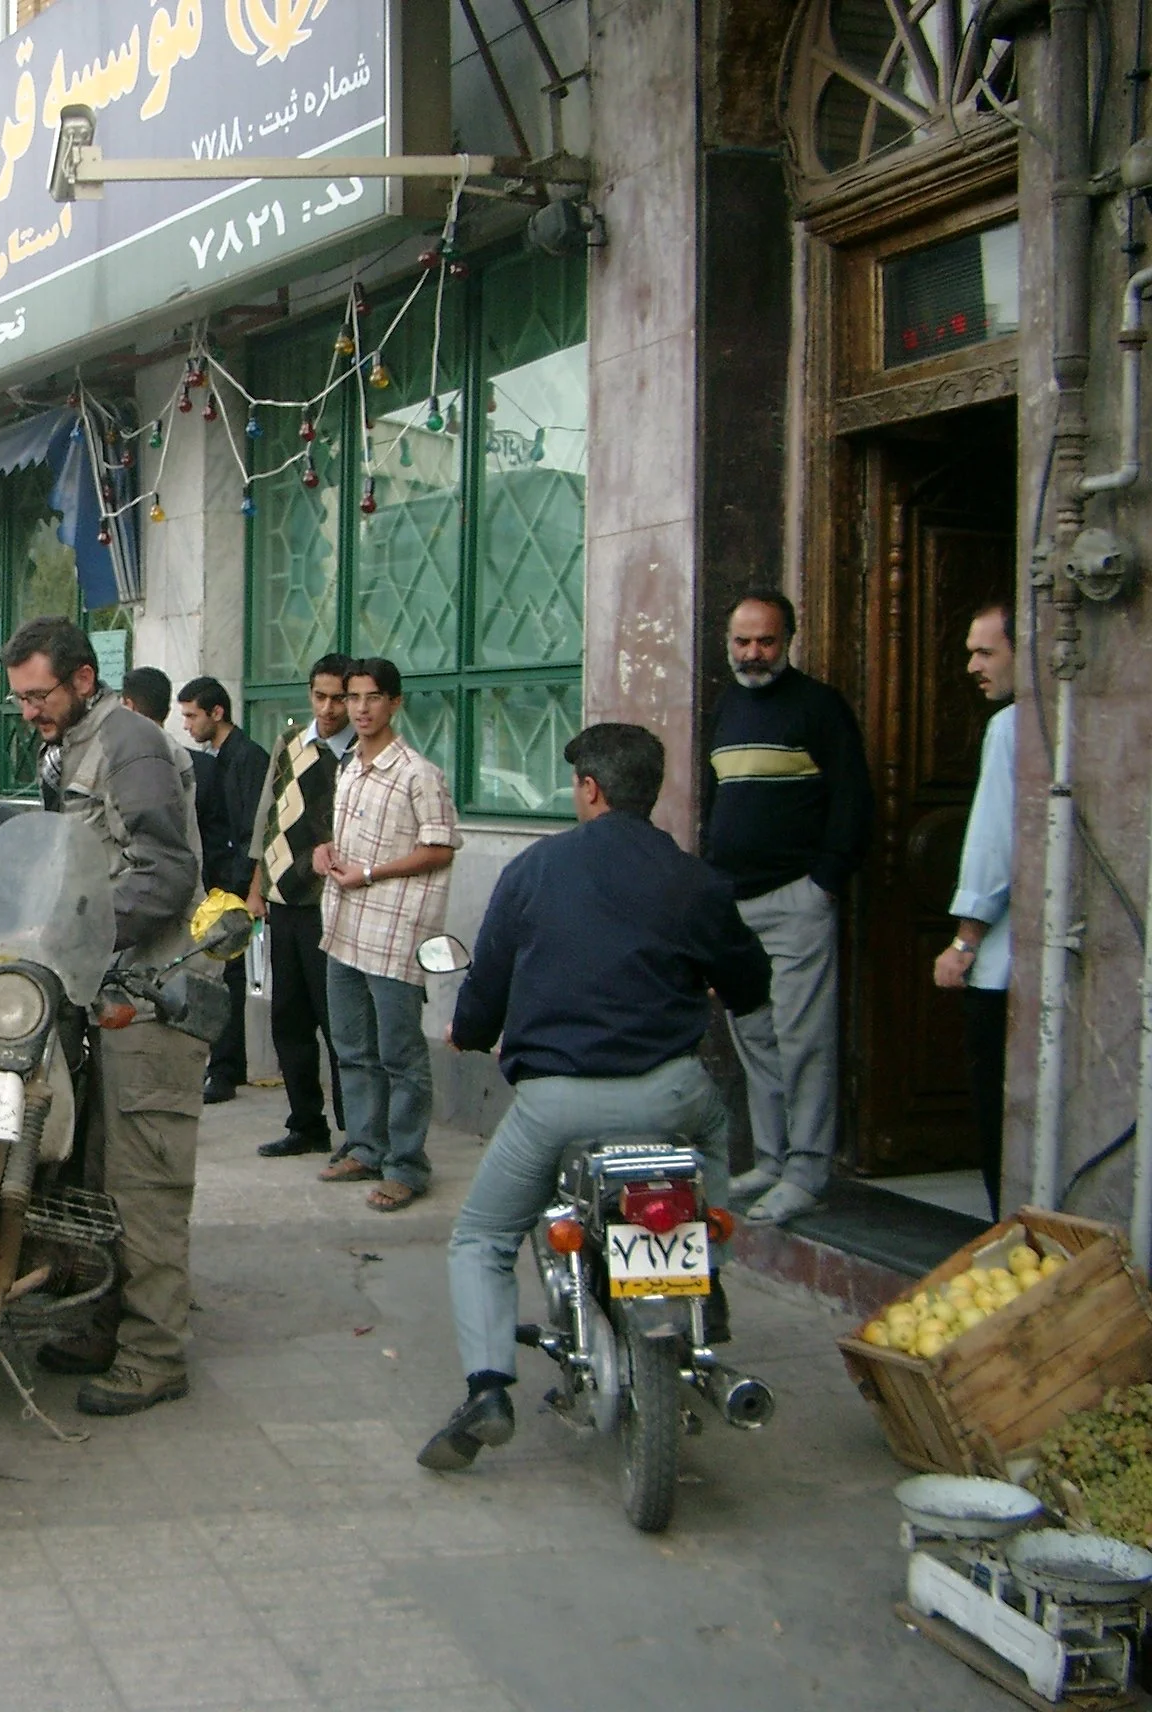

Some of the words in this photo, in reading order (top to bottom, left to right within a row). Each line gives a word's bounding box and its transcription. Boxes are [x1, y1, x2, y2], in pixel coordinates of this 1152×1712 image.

[304, 53, 370, 117] شماره
[191, 116, 243, 160] ۷۷۸۸
[189, 200, 286, 270] ۷۸۲۱
